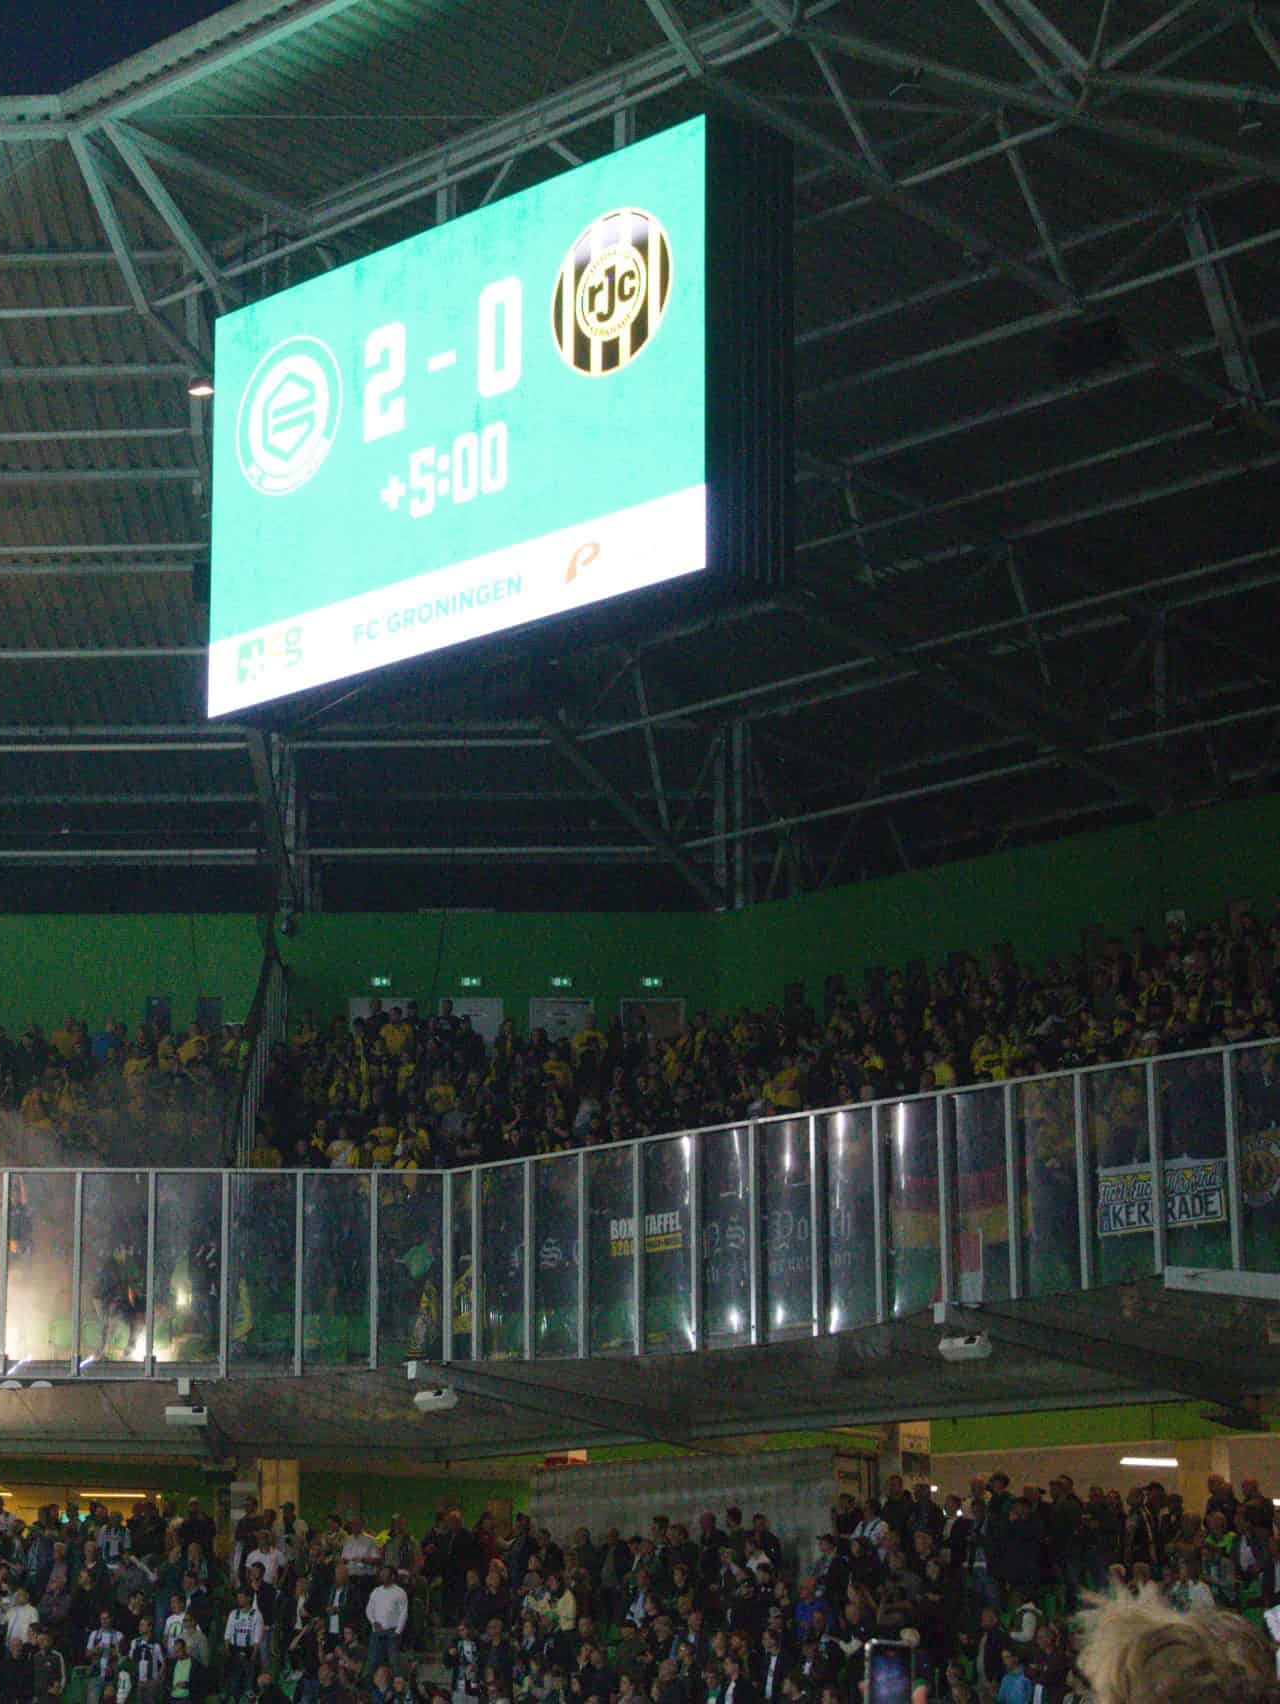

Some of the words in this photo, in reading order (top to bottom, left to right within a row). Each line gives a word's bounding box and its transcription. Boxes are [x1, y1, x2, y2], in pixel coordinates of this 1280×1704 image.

[363, 321, 406, 442] 2
[477, 275, 522, 399] 0
[380, 419, 508, 519] +5:00
[352, 616, 380, 648] FC
[386, 572, 524, 634] GRONINGEN
[1110, 1187, 1218, 1228] KERRADE
